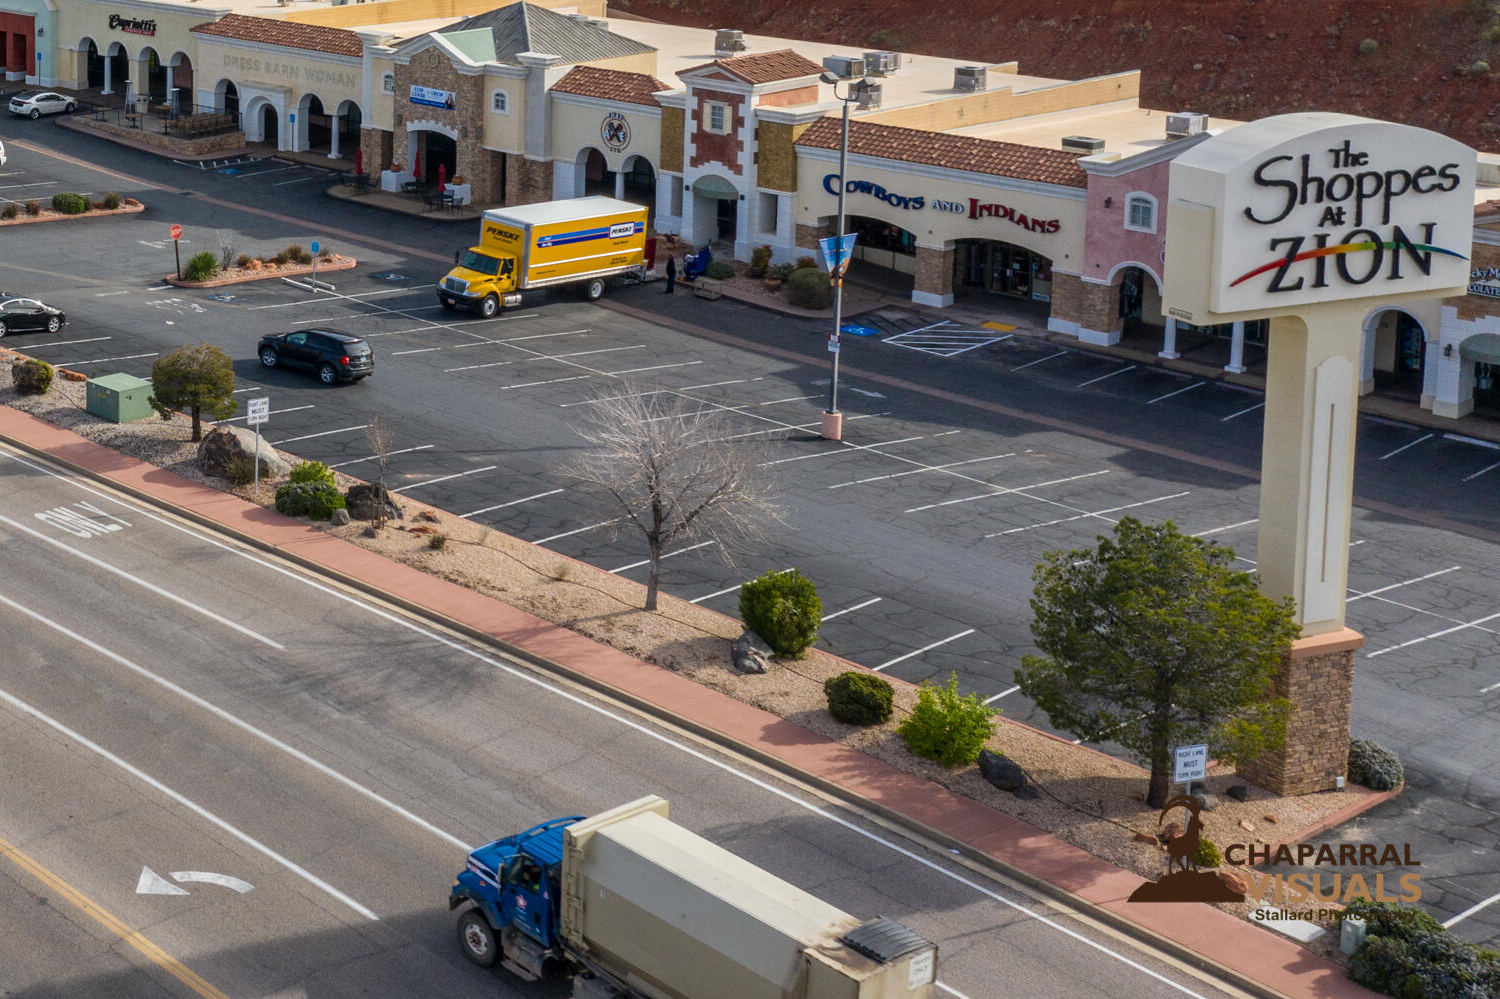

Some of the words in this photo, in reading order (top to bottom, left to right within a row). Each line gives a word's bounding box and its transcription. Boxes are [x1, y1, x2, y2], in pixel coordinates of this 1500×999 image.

[109, 13, 157, 32] Capriotti's
[223, 55, 260, 72] DRESS
[264, 62, 299, 78] BARN
[303, 67, 356, 89] WOMAN
[1328, 140, 1369, 168] The
[1244, 154, 1460, 227] Shoppes
[823, 173, 925, 211] COWBOYS
[932, 199, 965, 215] AND
[969, 198, 1060, 234] INDIANS
[1318, 206, 1346, 227] At
[486, 226, 520, 242] PENSKE
[611, 226, 632, 235] PENSKE
[1267, 222, 1437, 293] ZION
[1467, 284, 1500, 297] COLATE
[34, 501, 133, 538] ONLY
[1184, 760, 1198, 768] MUST
